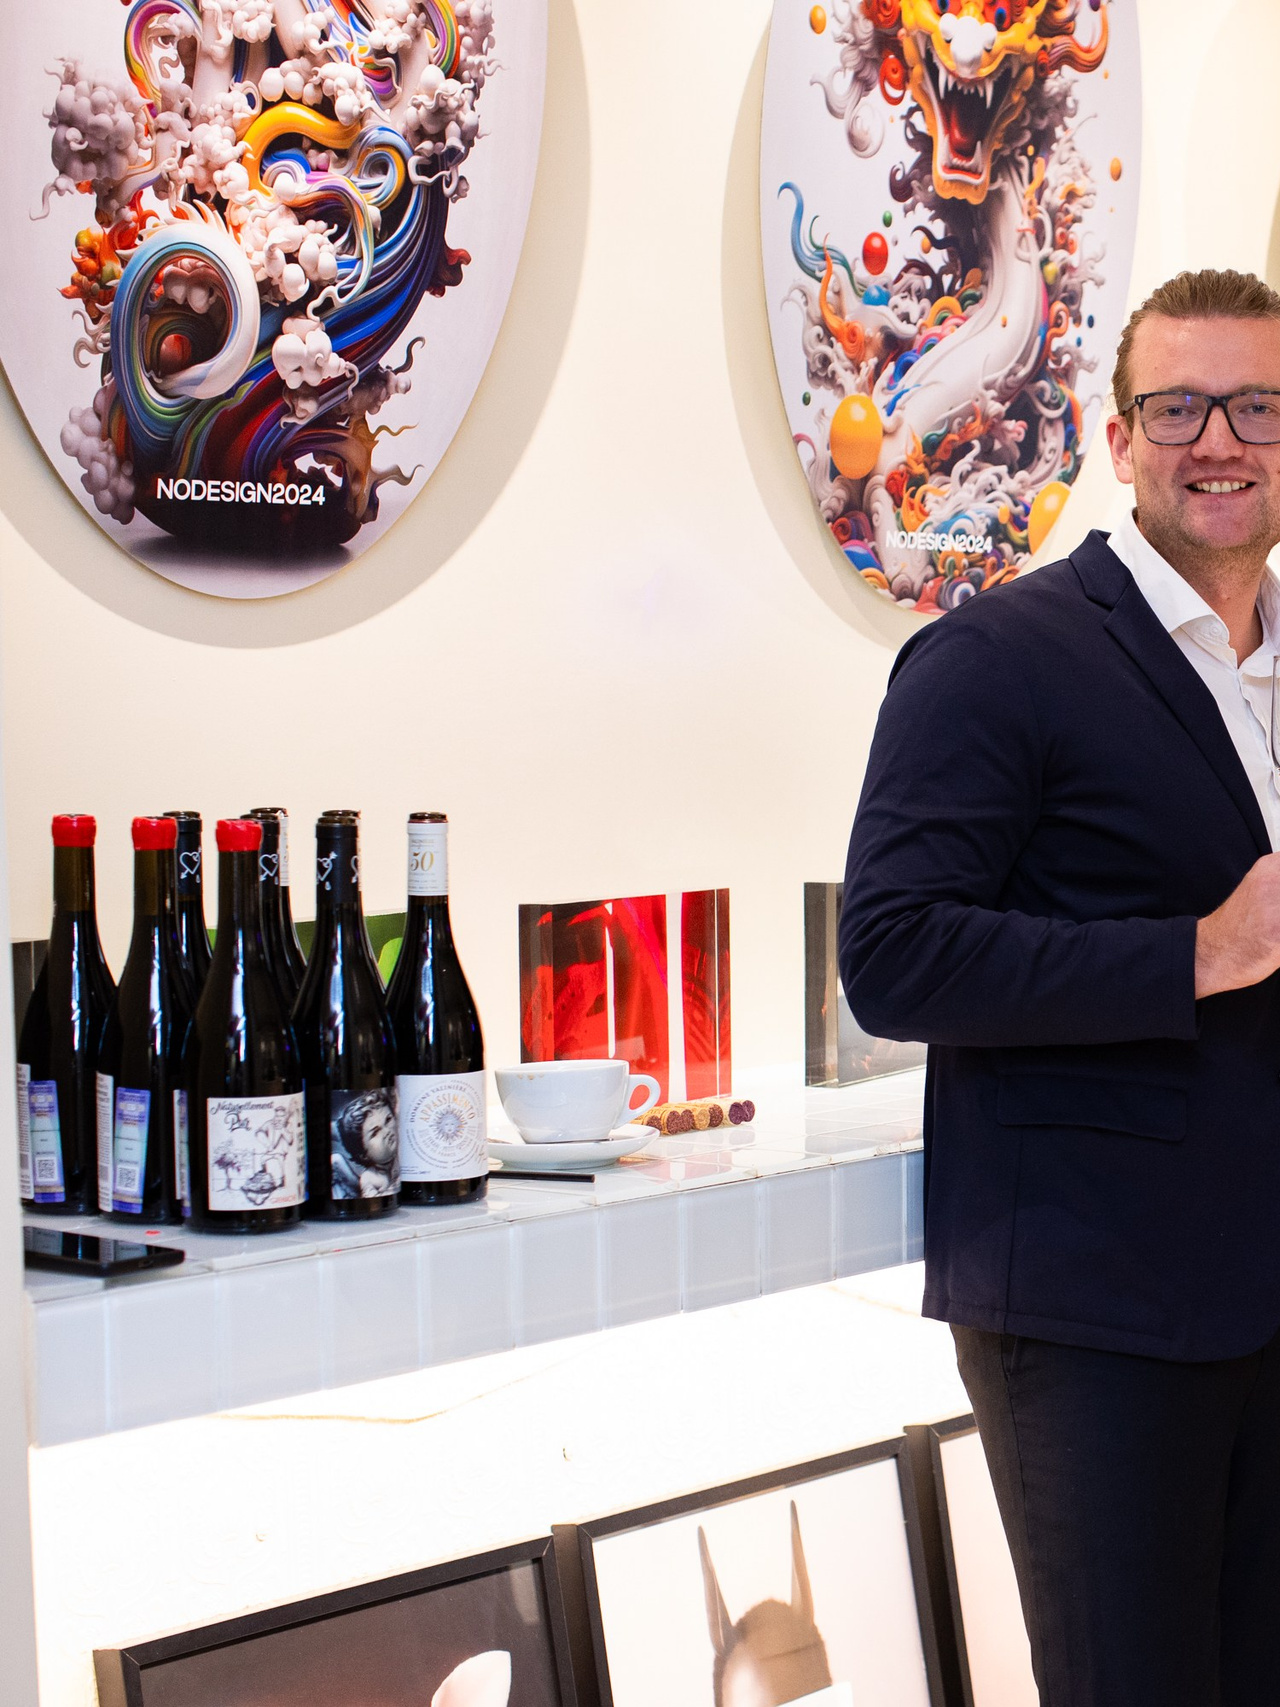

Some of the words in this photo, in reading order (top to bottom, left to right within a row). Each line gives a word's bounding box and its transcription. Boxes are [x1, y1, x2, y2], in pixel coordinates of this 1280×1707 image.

[156, 477, 326, 505] NODESIGN2024
[886, 530, 993, 553] NODESIGN2024
[410, 850, 435, 872] 50
[409, 1092, 431, 1123] DOMAINE
[419, 1093, 476, 1123] APPASSIMENTO
